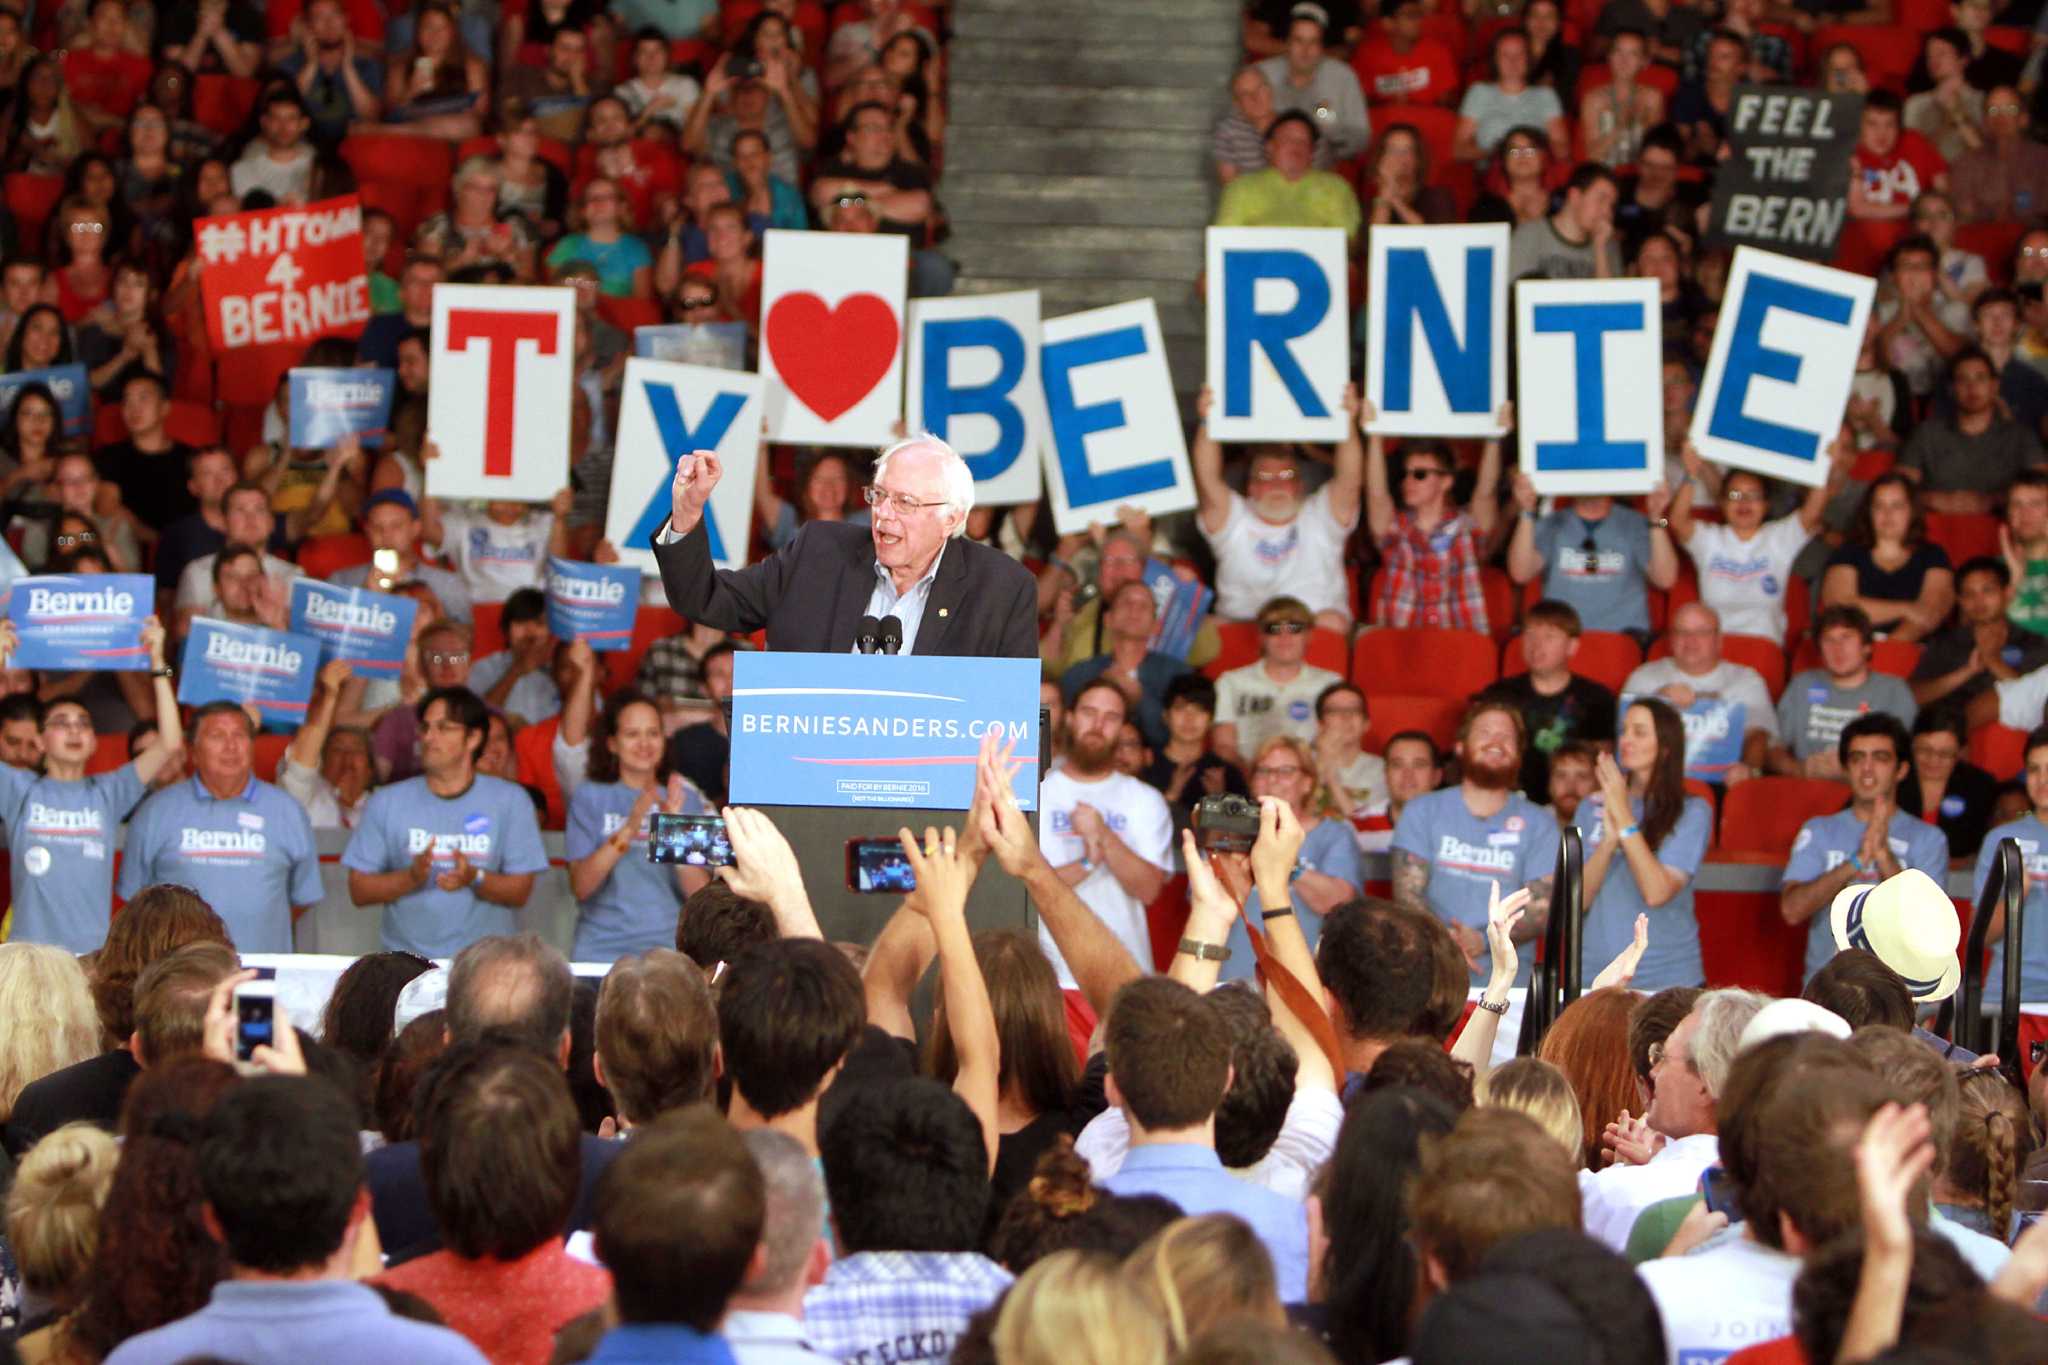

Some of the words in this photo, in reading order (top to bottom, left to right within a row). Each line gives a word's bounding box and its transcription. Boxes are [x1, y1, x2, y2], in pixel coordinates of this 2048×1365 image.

[1734, 94, 1835, 139] FEEL
[1746, 146, 1817, 182] THE
[1724, 194, 1847, 247] BERN
[265, 251, 303, 291] 4
[219, 274, 369, 348] BERNIE
[27, 586, 134, 615] Bernie
[552, 574, 624, 605] ernie
[305, 591, 396, 634] Bernie
[205, 631, 302, 673] Bernie
[742, 713, 1028, 740] BERNIESANDERS.COM
[27, 803, 104, 829] Bernie
[180, 827, 266, 852] Bernie
[1439, 835, 1515, 872] Bernie
